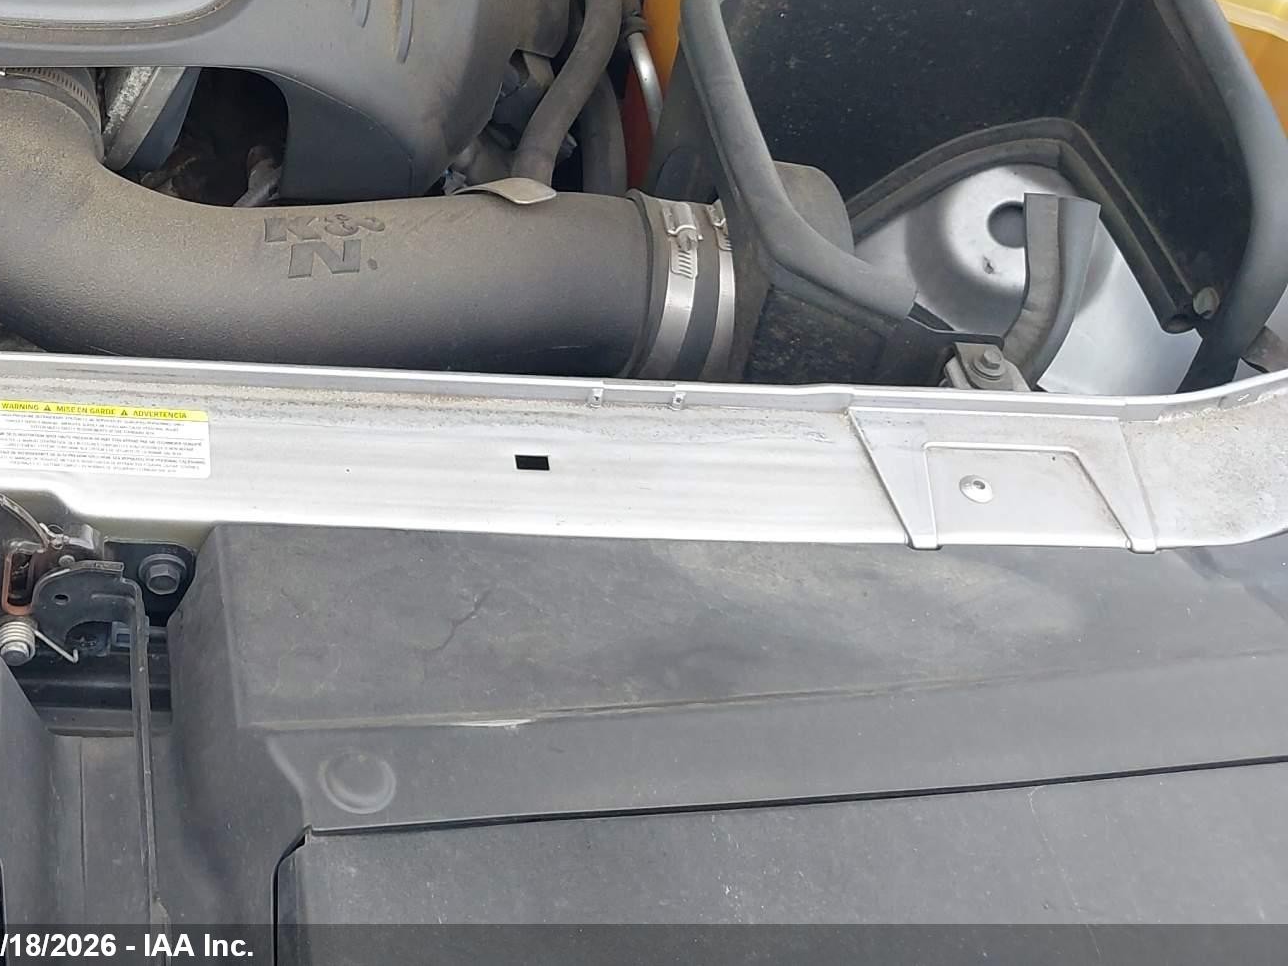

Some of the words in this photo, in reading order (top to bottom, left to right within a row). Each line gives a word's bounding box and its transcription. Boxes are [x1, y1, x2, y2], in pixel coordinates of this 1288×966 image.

[1, 402, 39, 410] WARNING
[56, 405, 77, 413] MISE
[89, 407, 116, 415] GARDE
[133, 409, 187, 419] ADVERTENCIA
